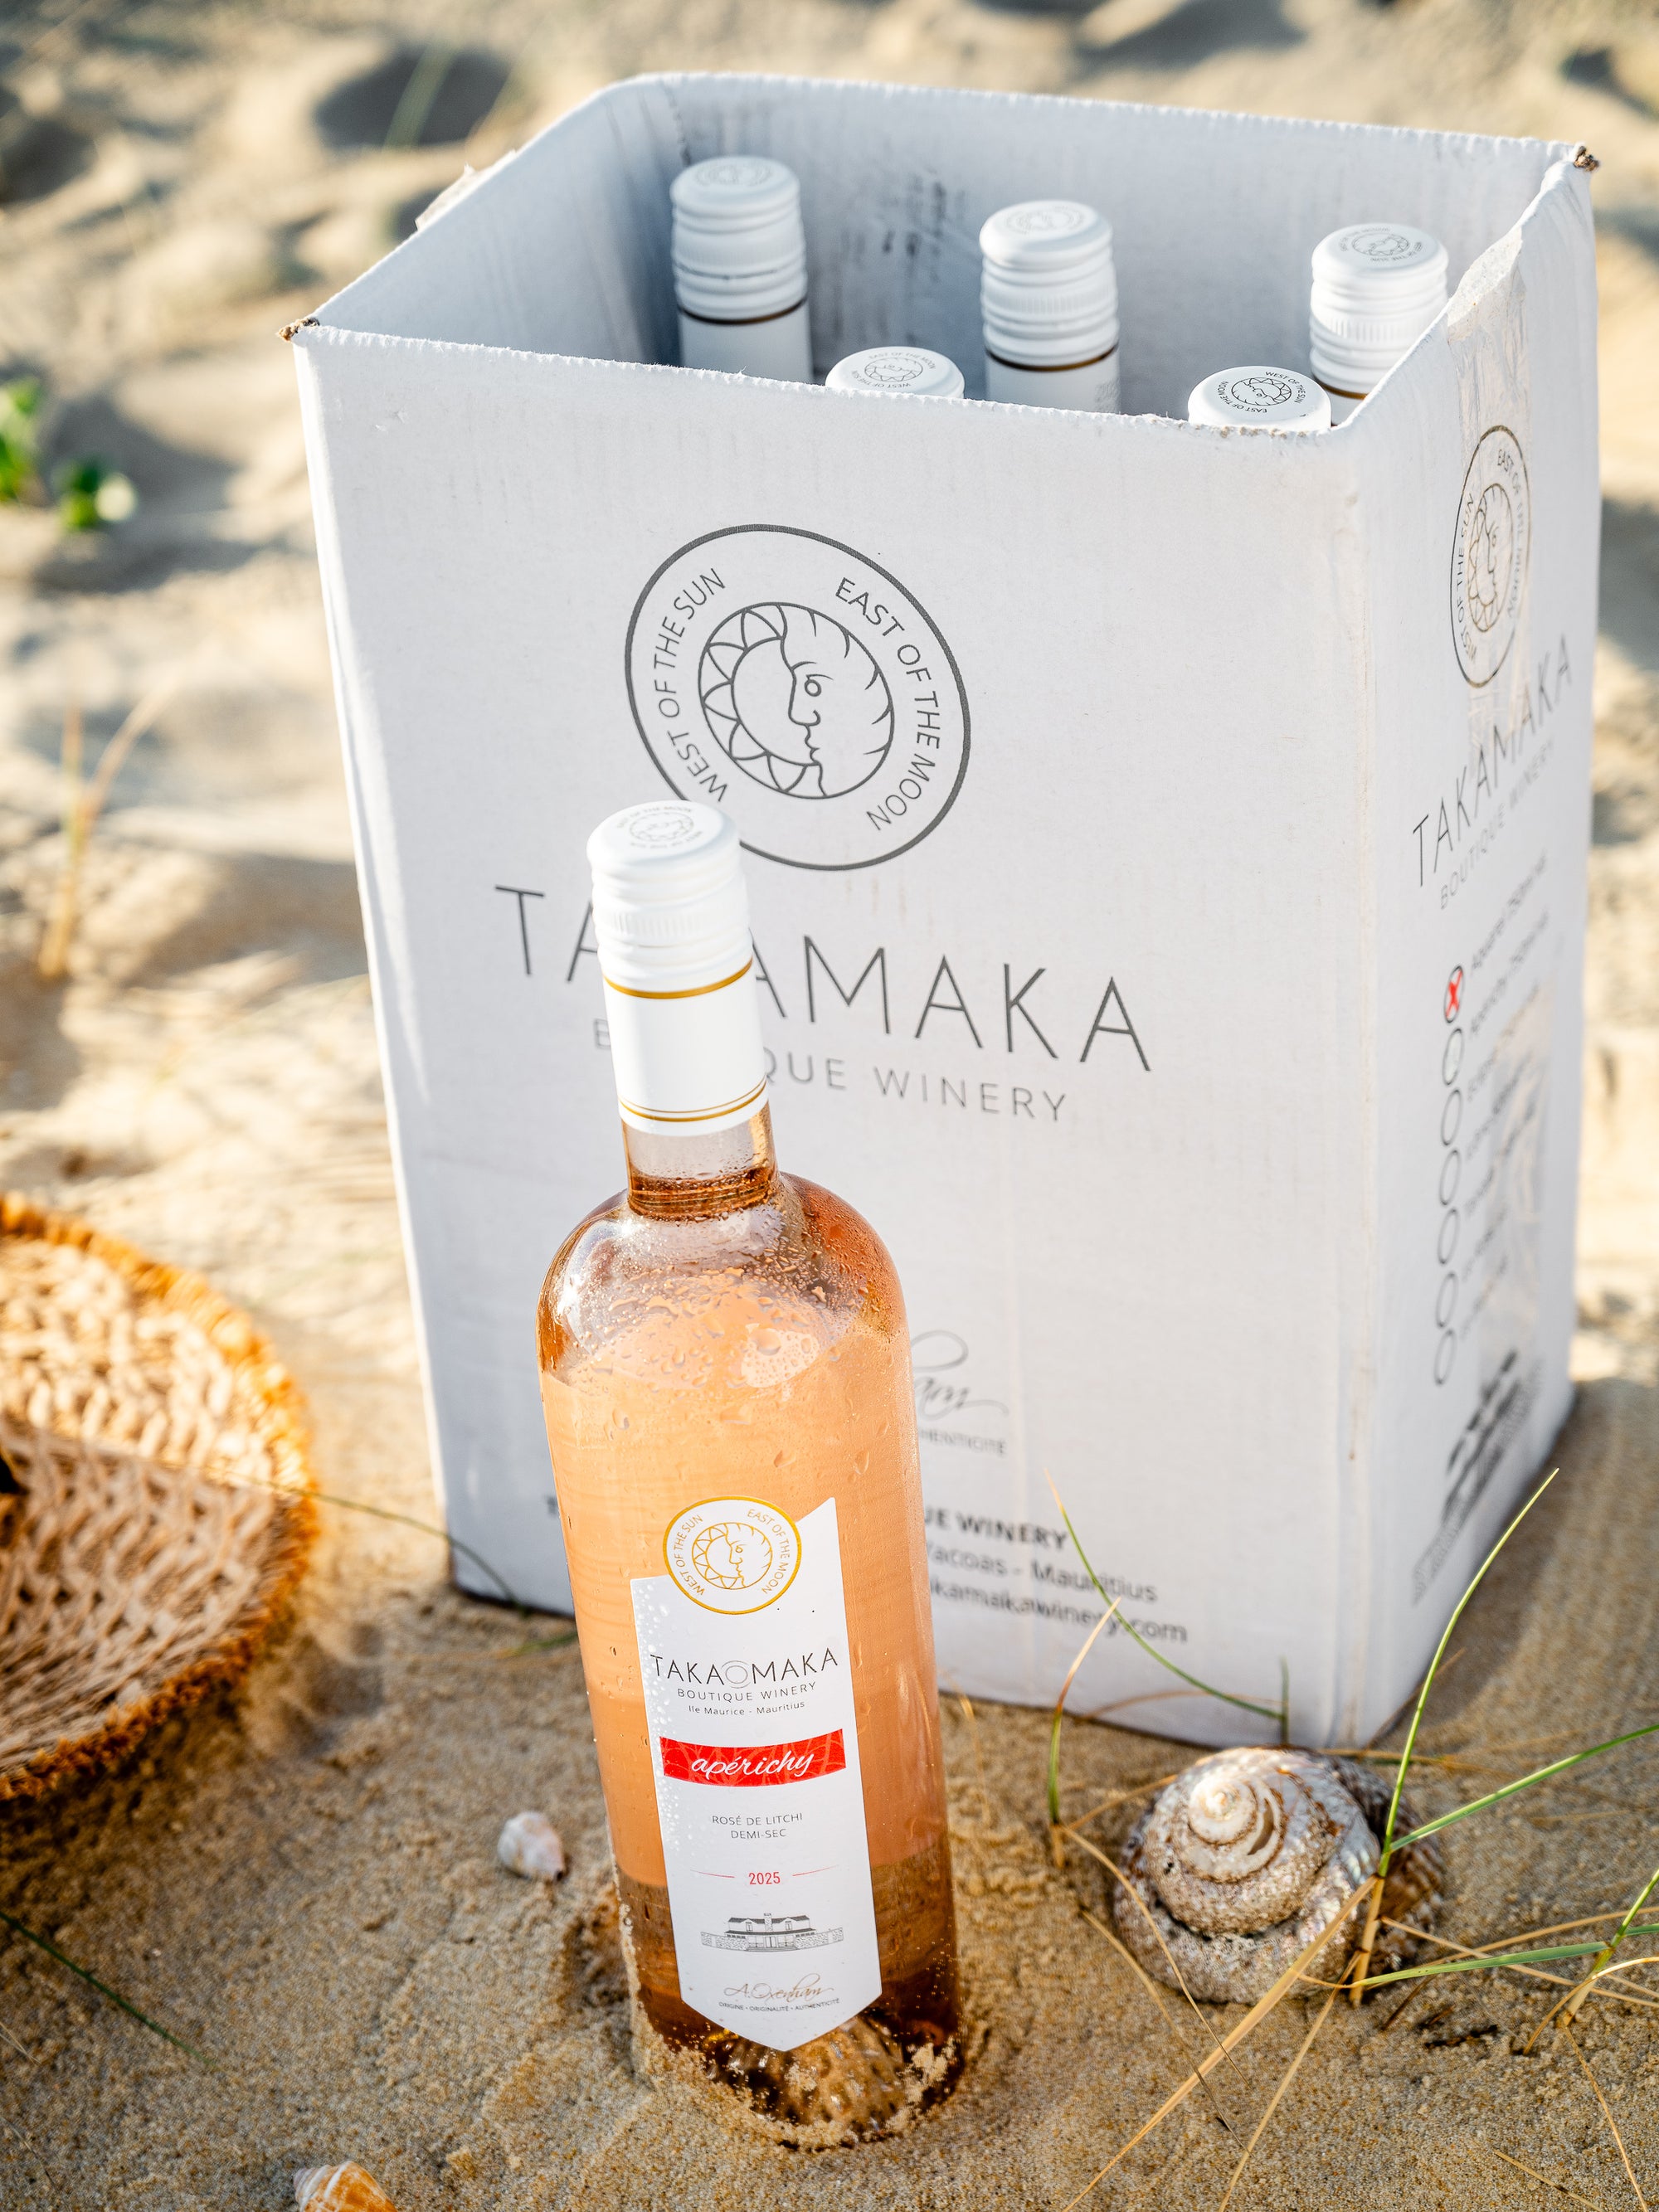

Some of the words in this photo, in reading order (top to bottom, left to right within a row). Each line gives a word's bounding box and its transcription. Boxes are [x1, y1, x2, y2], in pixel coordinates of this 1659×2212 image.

[1265, 371, 1289, 380] WEST
[674, 567, 726, 620] SUN
[834, 577, 905, 637] EAST
[654, 616, 685, 670] THE
[897, 644, 932, 683] OF
[654, 678, 680, 718] OF
[914, 691, 941, 749] THE
[667, 729, 730, 802] WEST
[866, 755, 936, 831] MOON
[495, 884, 1151, 1072] TAAMAKA
[873, 1066, 1067, 1123] WINERY
[682, 1514, 703, 1533] SUN
[747, 1509, 776, 1525] EAST
[956, 1511, 1068, 1550] WINERY
[674, 1532, 687, 1551] THE
[771, 1524, 786, 1538] OF
[674, 1553, 686, 1568] OF
[779, 1538, 791, 1559] THE
[680, 1571, 706, 1596] WEST
[761, 1562, 790, 1594] MOON
[678, 1688, 753, 1703] BOUTIQUE
[760, 1681, 816, 1699] WINERY
[704, 1706, 746, 1716] Maurice
[757, 1701, 805, 1714] Mauritius
[691, 1750, 815, 1780] apérichy
[712, 1815, 742, 1826] ROSÉ
[746, 1816, 762, 1826] DE
[766, 1812, 803, 1826] LITCHI
[731, 1828, 787, 1840] DEMI-SEC
[748, 1871, 781, 1885] 2025
